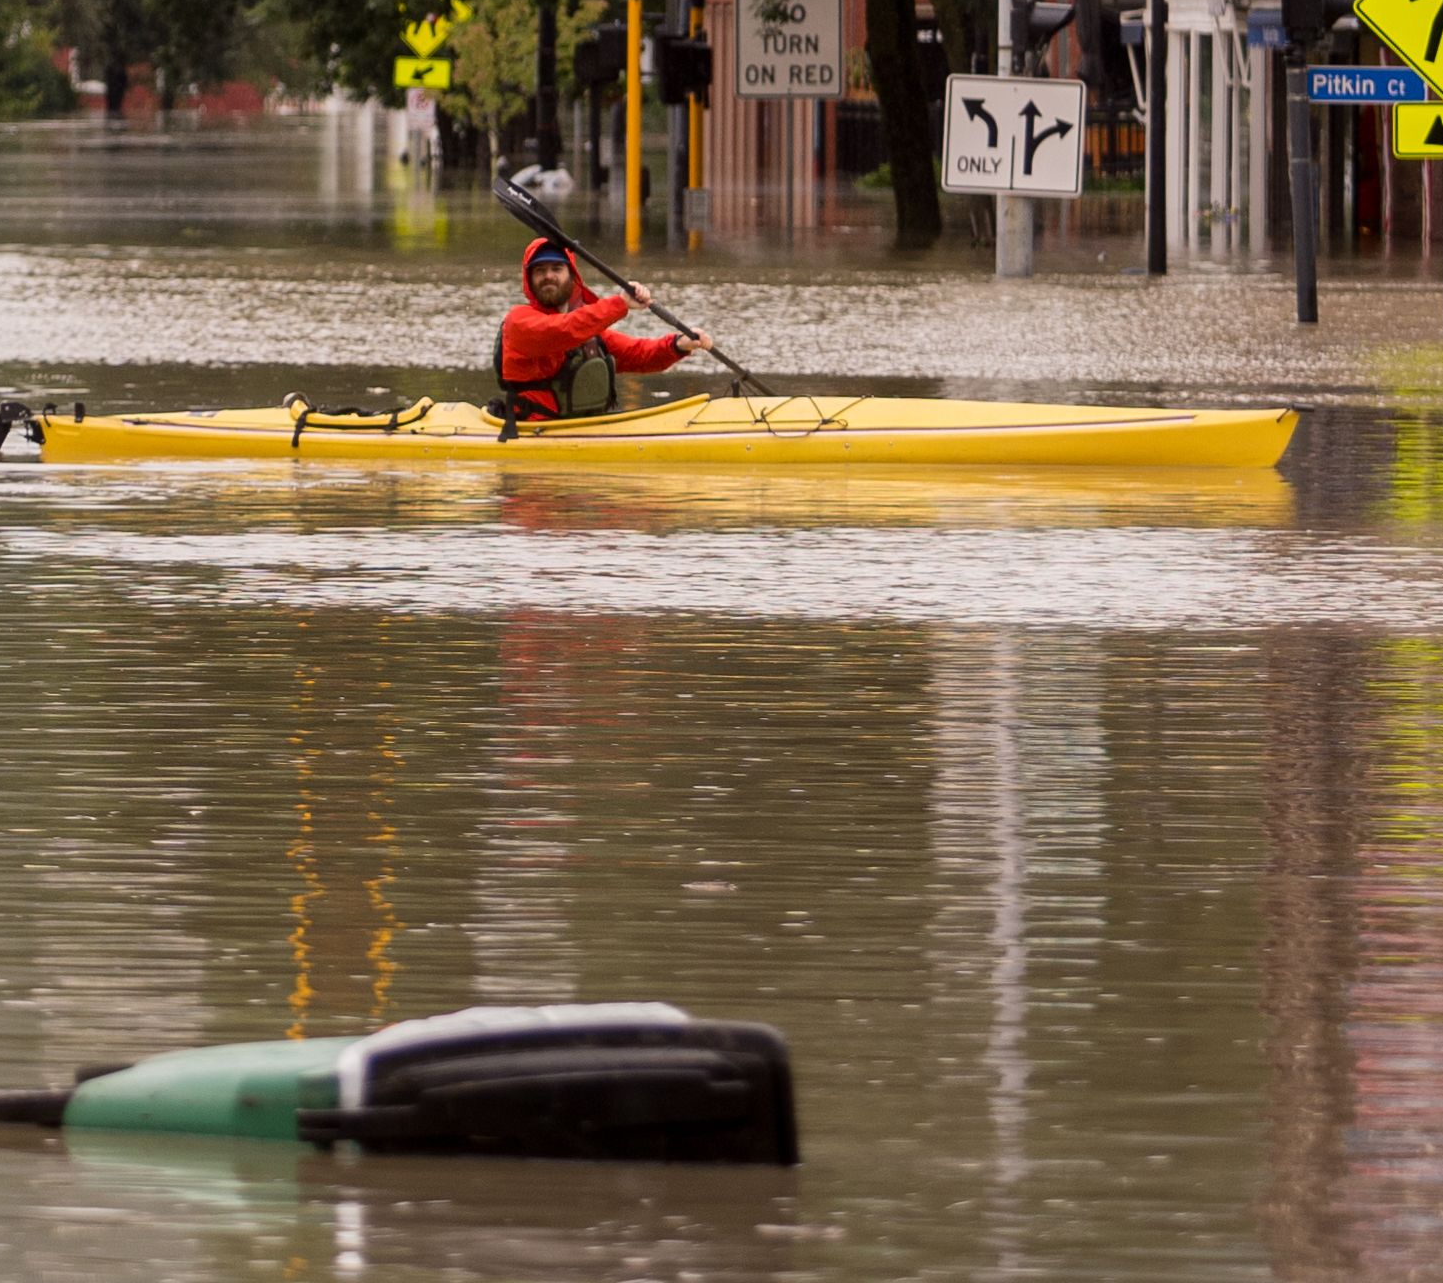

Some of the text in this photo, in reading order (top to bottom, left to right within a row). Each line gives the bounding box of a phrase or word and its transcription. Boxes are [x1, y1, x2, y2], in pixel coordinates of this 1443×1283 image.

[760, 33, 820, 55] TURN
[744, 63, 834, 86] ON RED
[1313, 73, 1406, 97] Pitkin Ct
[956, 155, 1003, 175] ONLY
